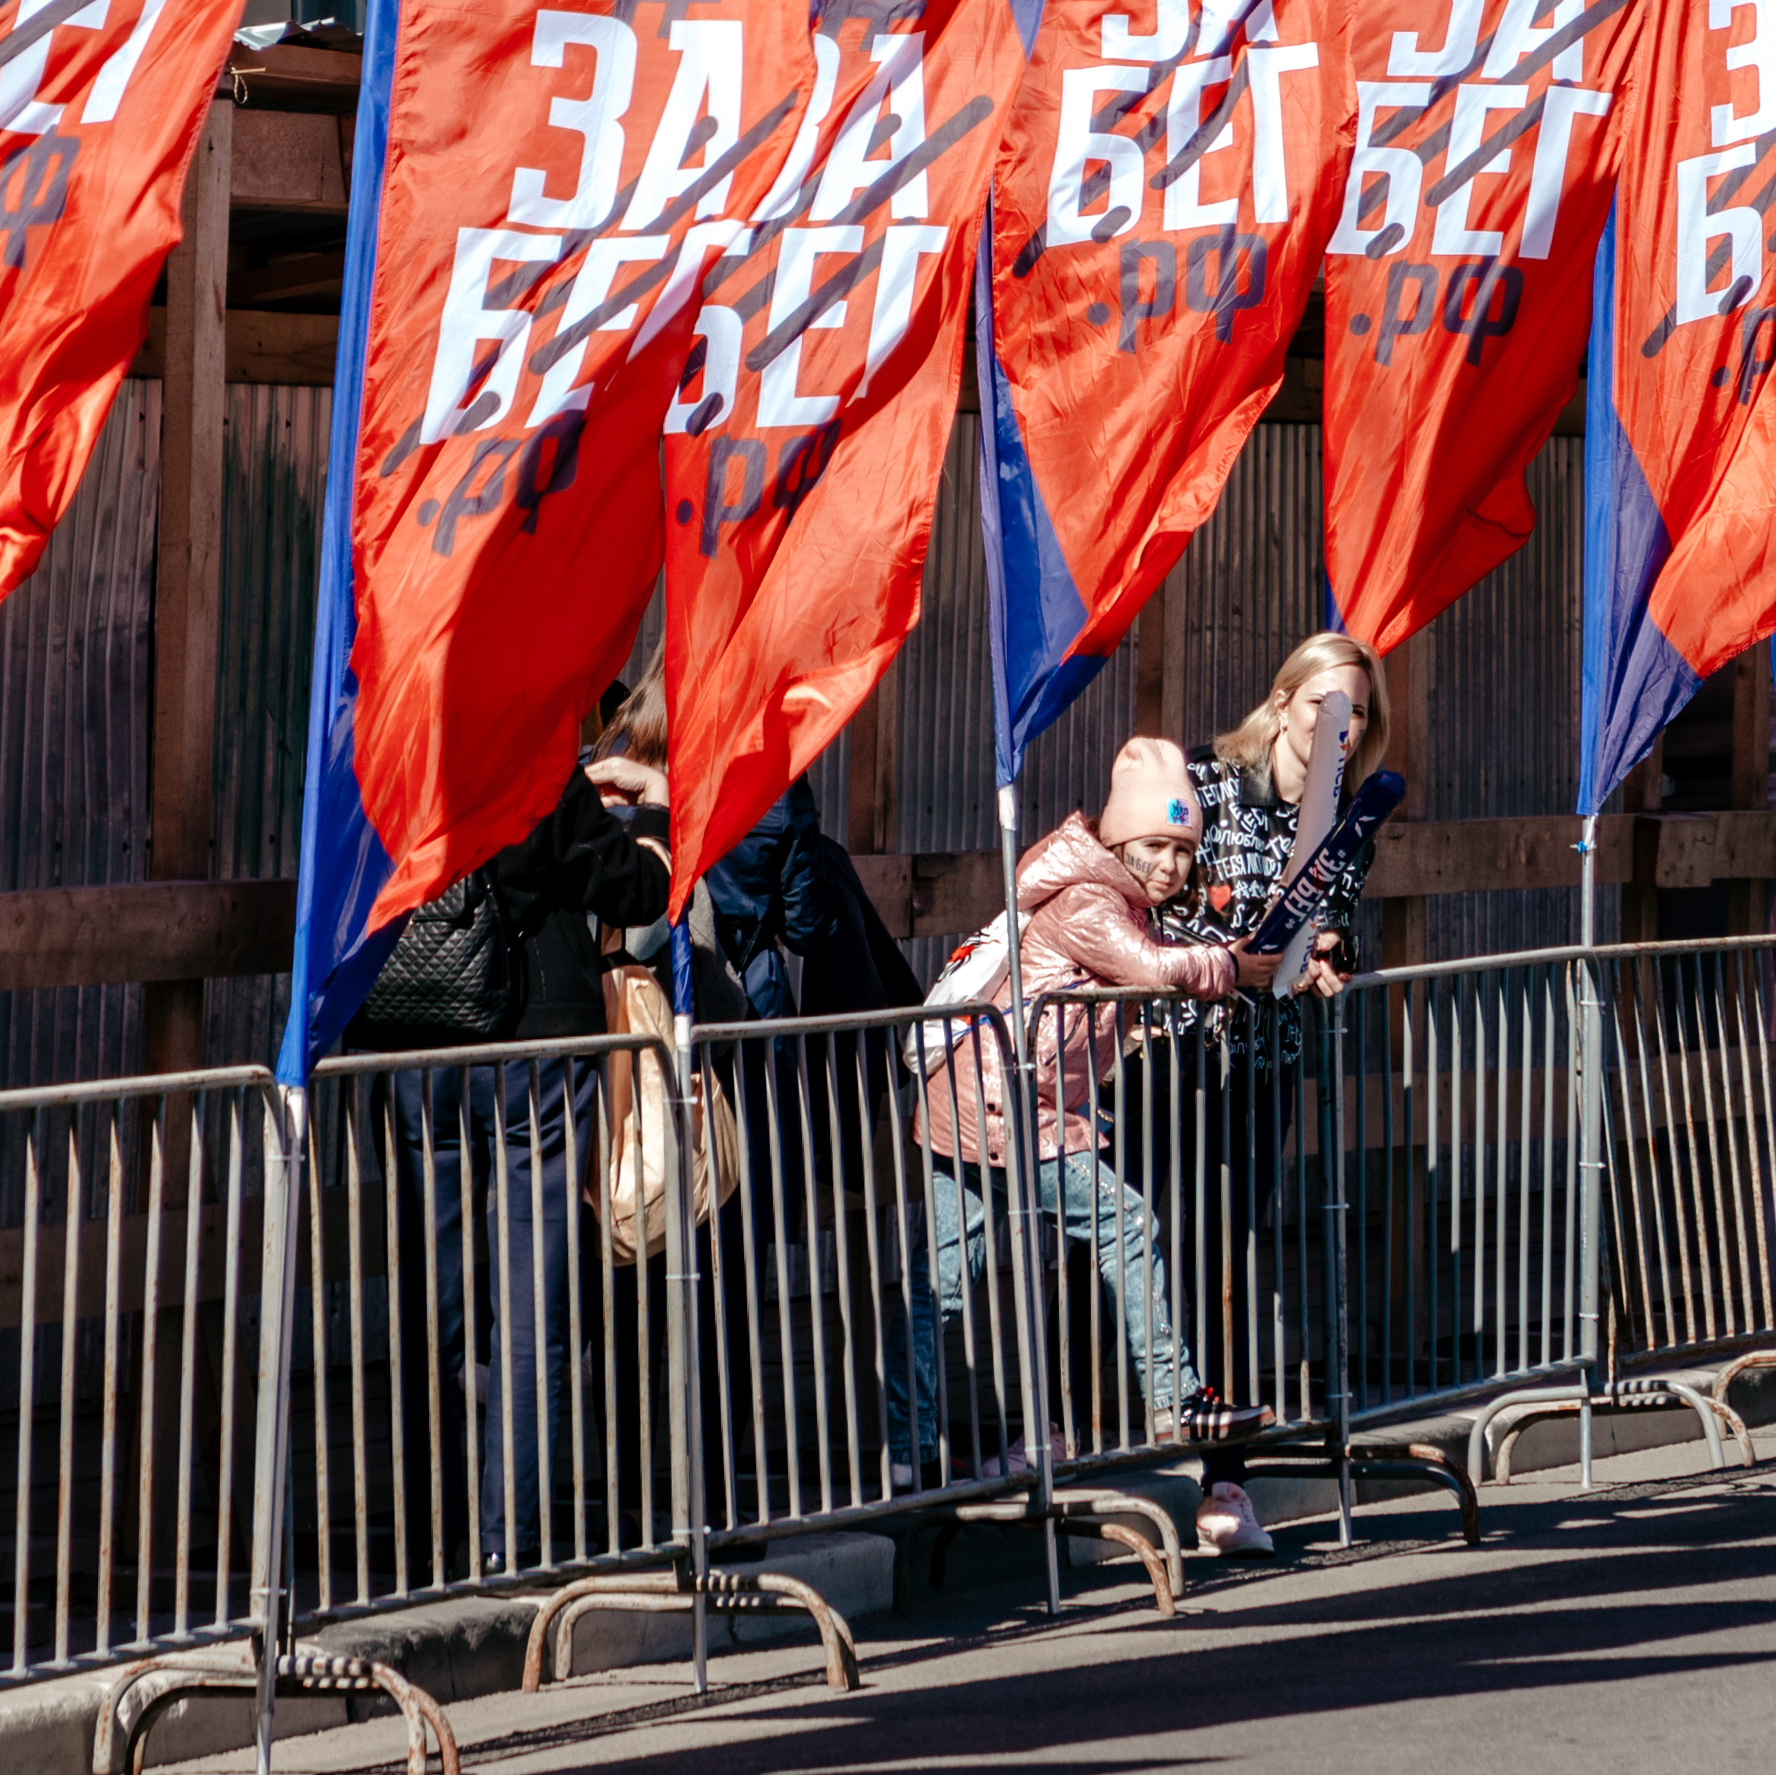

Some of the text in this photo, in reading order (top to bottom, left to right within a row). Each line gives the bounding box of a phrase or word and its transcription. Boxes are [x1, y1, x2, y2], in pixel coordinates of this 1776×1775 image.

[507, 9, 742, 230] ЗА
[1047, 43, 1321, 247] БЕГ
[1326, 80, 1609, 260] БЕГ
